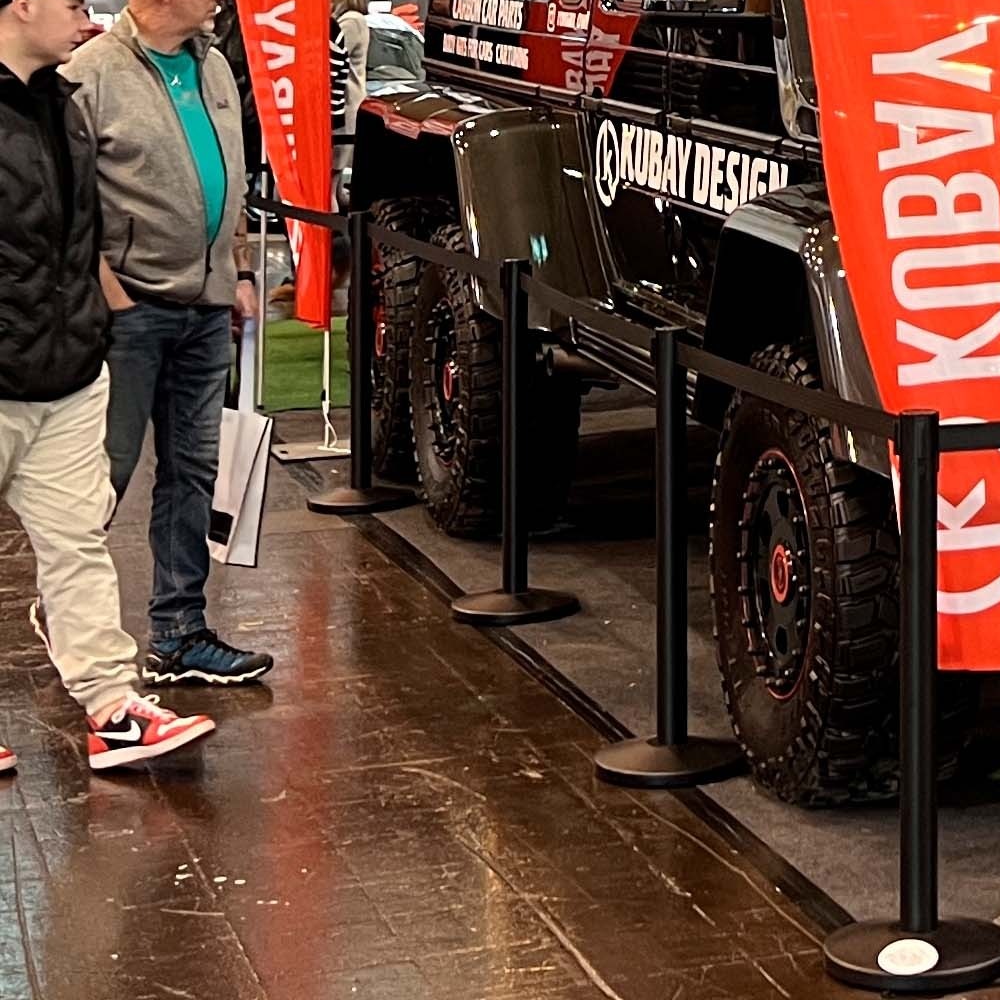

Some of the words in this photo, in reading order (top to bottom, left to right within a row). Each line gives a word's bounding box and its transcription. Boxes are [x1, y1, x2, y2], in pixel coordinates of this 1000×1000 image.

[497, 0, 524, 31] PARTS
[620, 122, 693, 199] KUBAY
[692, 142, 789, 215] DESIGN
